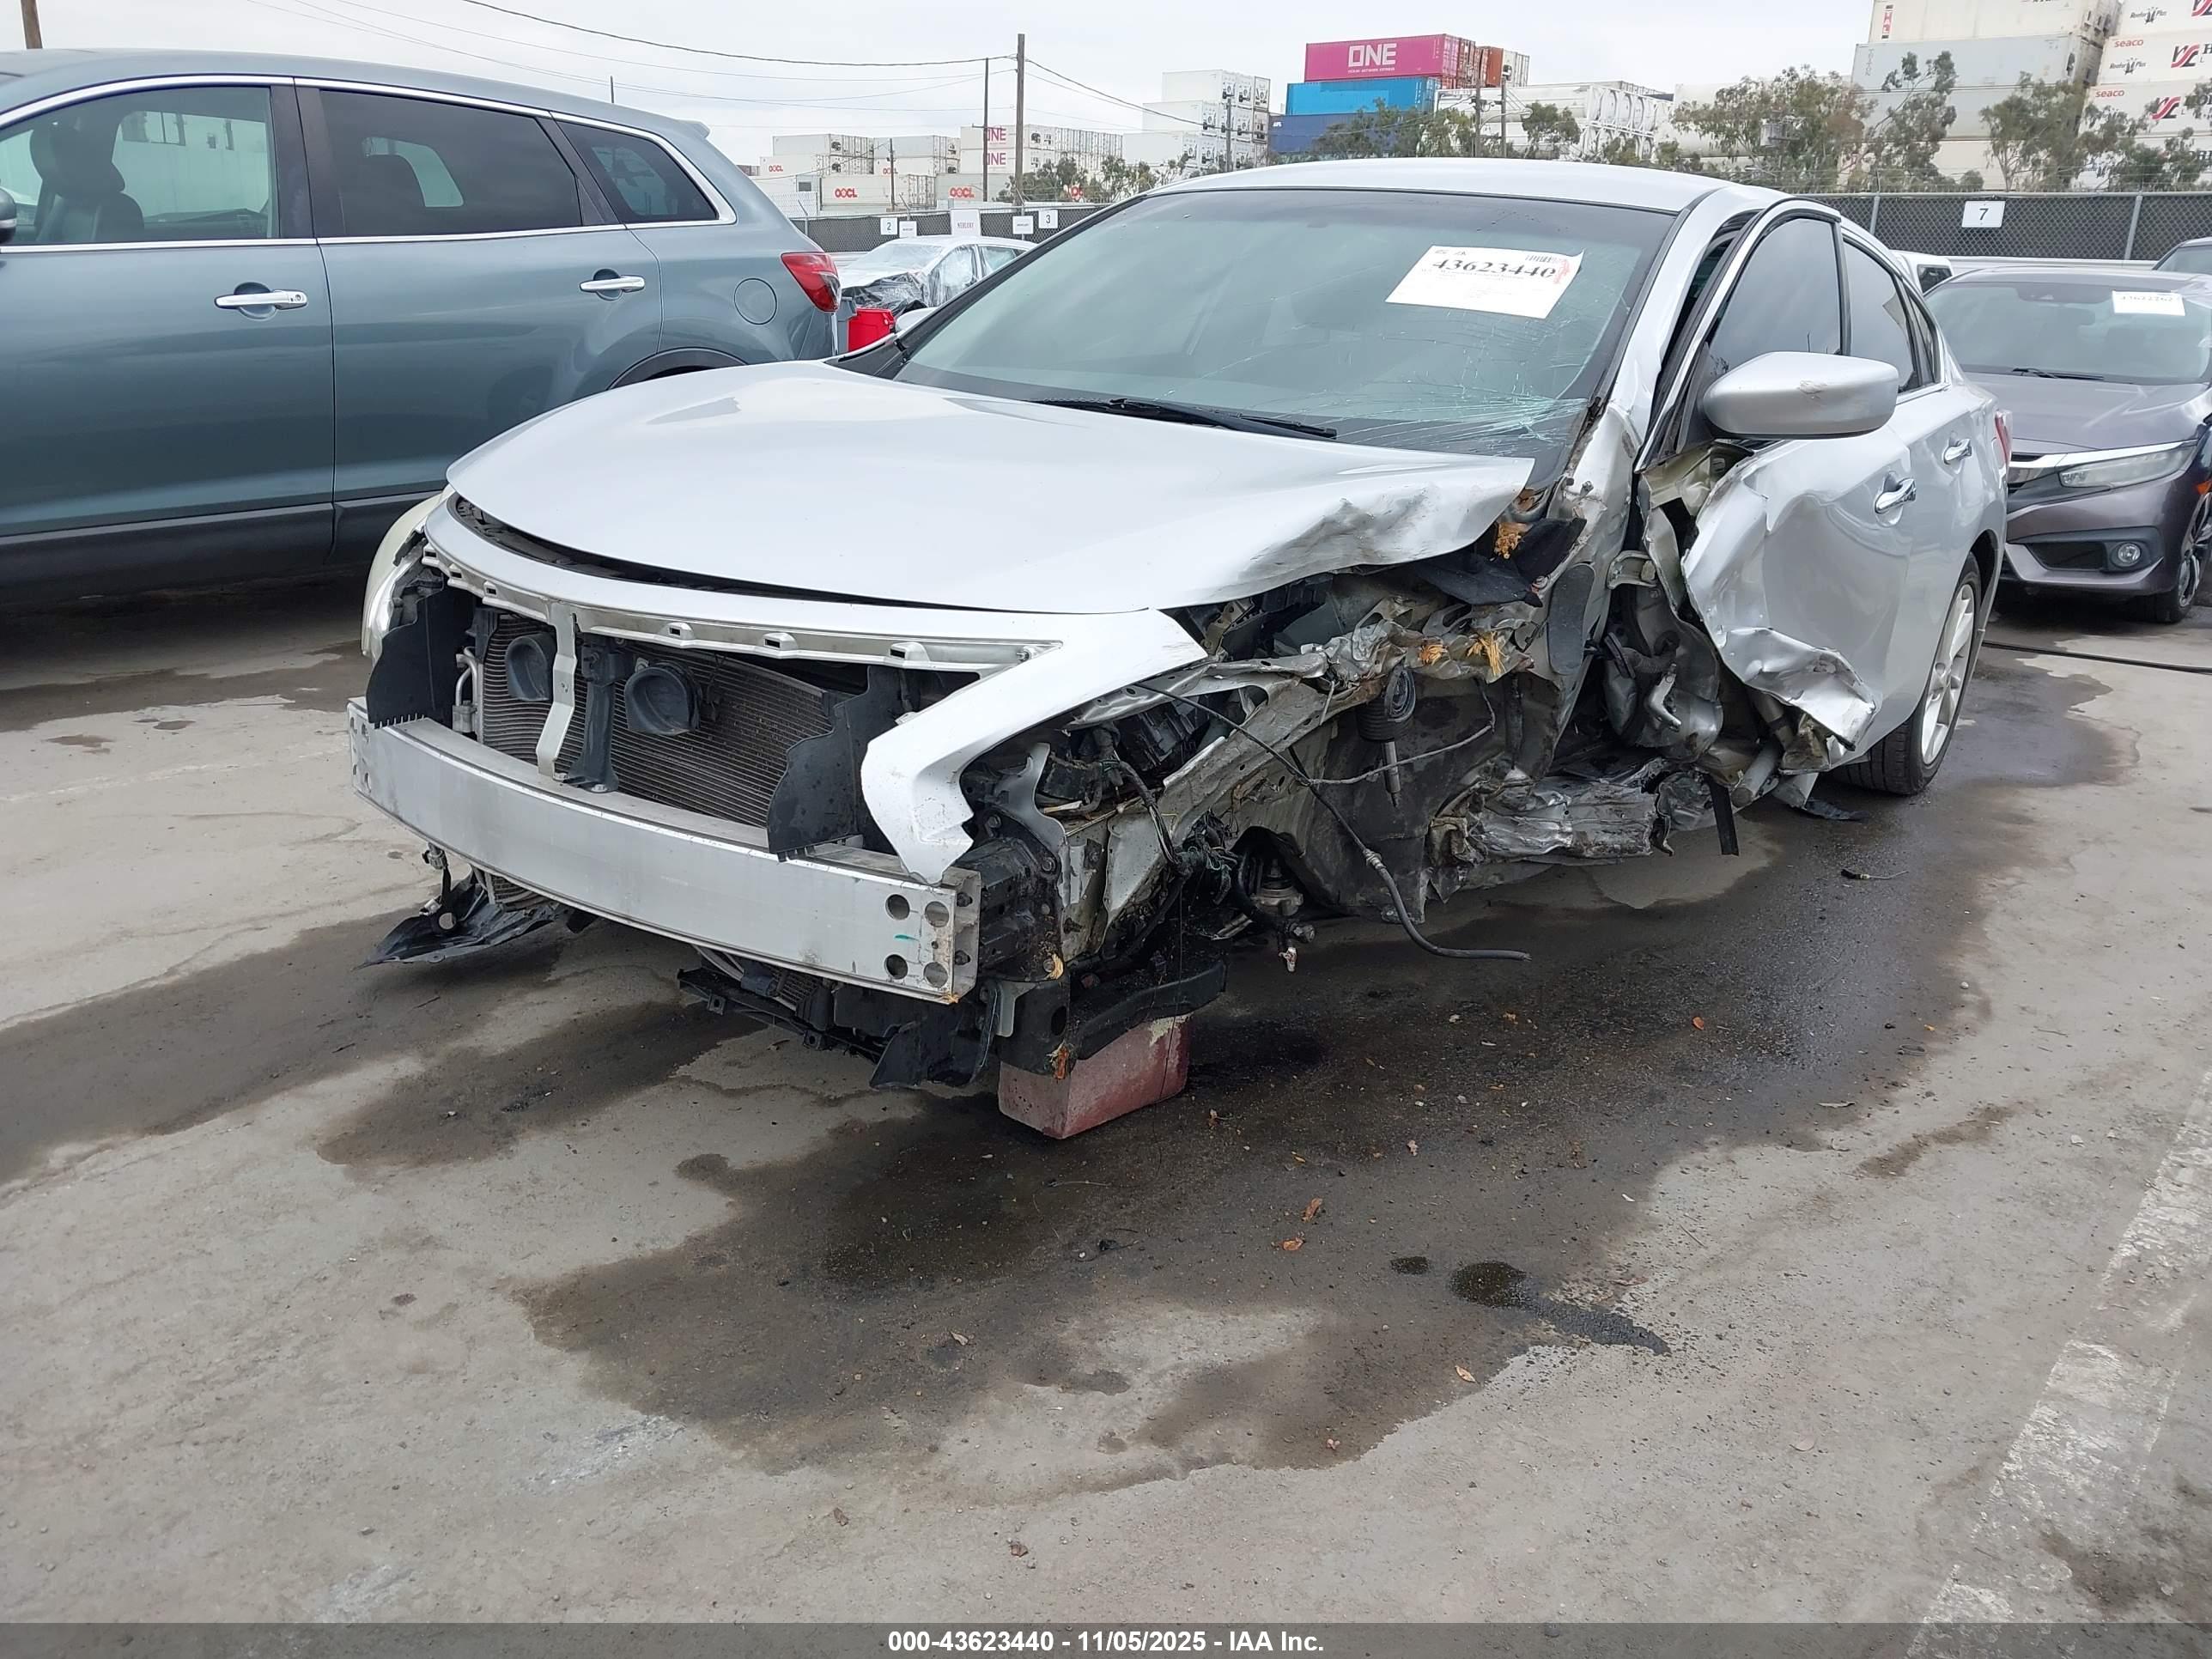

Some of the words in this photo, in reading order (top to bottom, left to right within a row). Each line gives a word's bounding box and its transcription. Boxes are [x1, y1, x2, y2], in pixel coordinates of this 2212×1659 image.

[2113, 39, 2144, 48] seaco
[1348, 43, 1397, 67] ONE
[2095, 89, 2125, 98] seaco
[835, 188, 857, 198] OOCL
[1045, 214, 1051, 224] 3
[1979, 208, 1989, 221] 7
[886, 222, 891, 231] 2
[1432, 258, 1556, 278] 43623440
